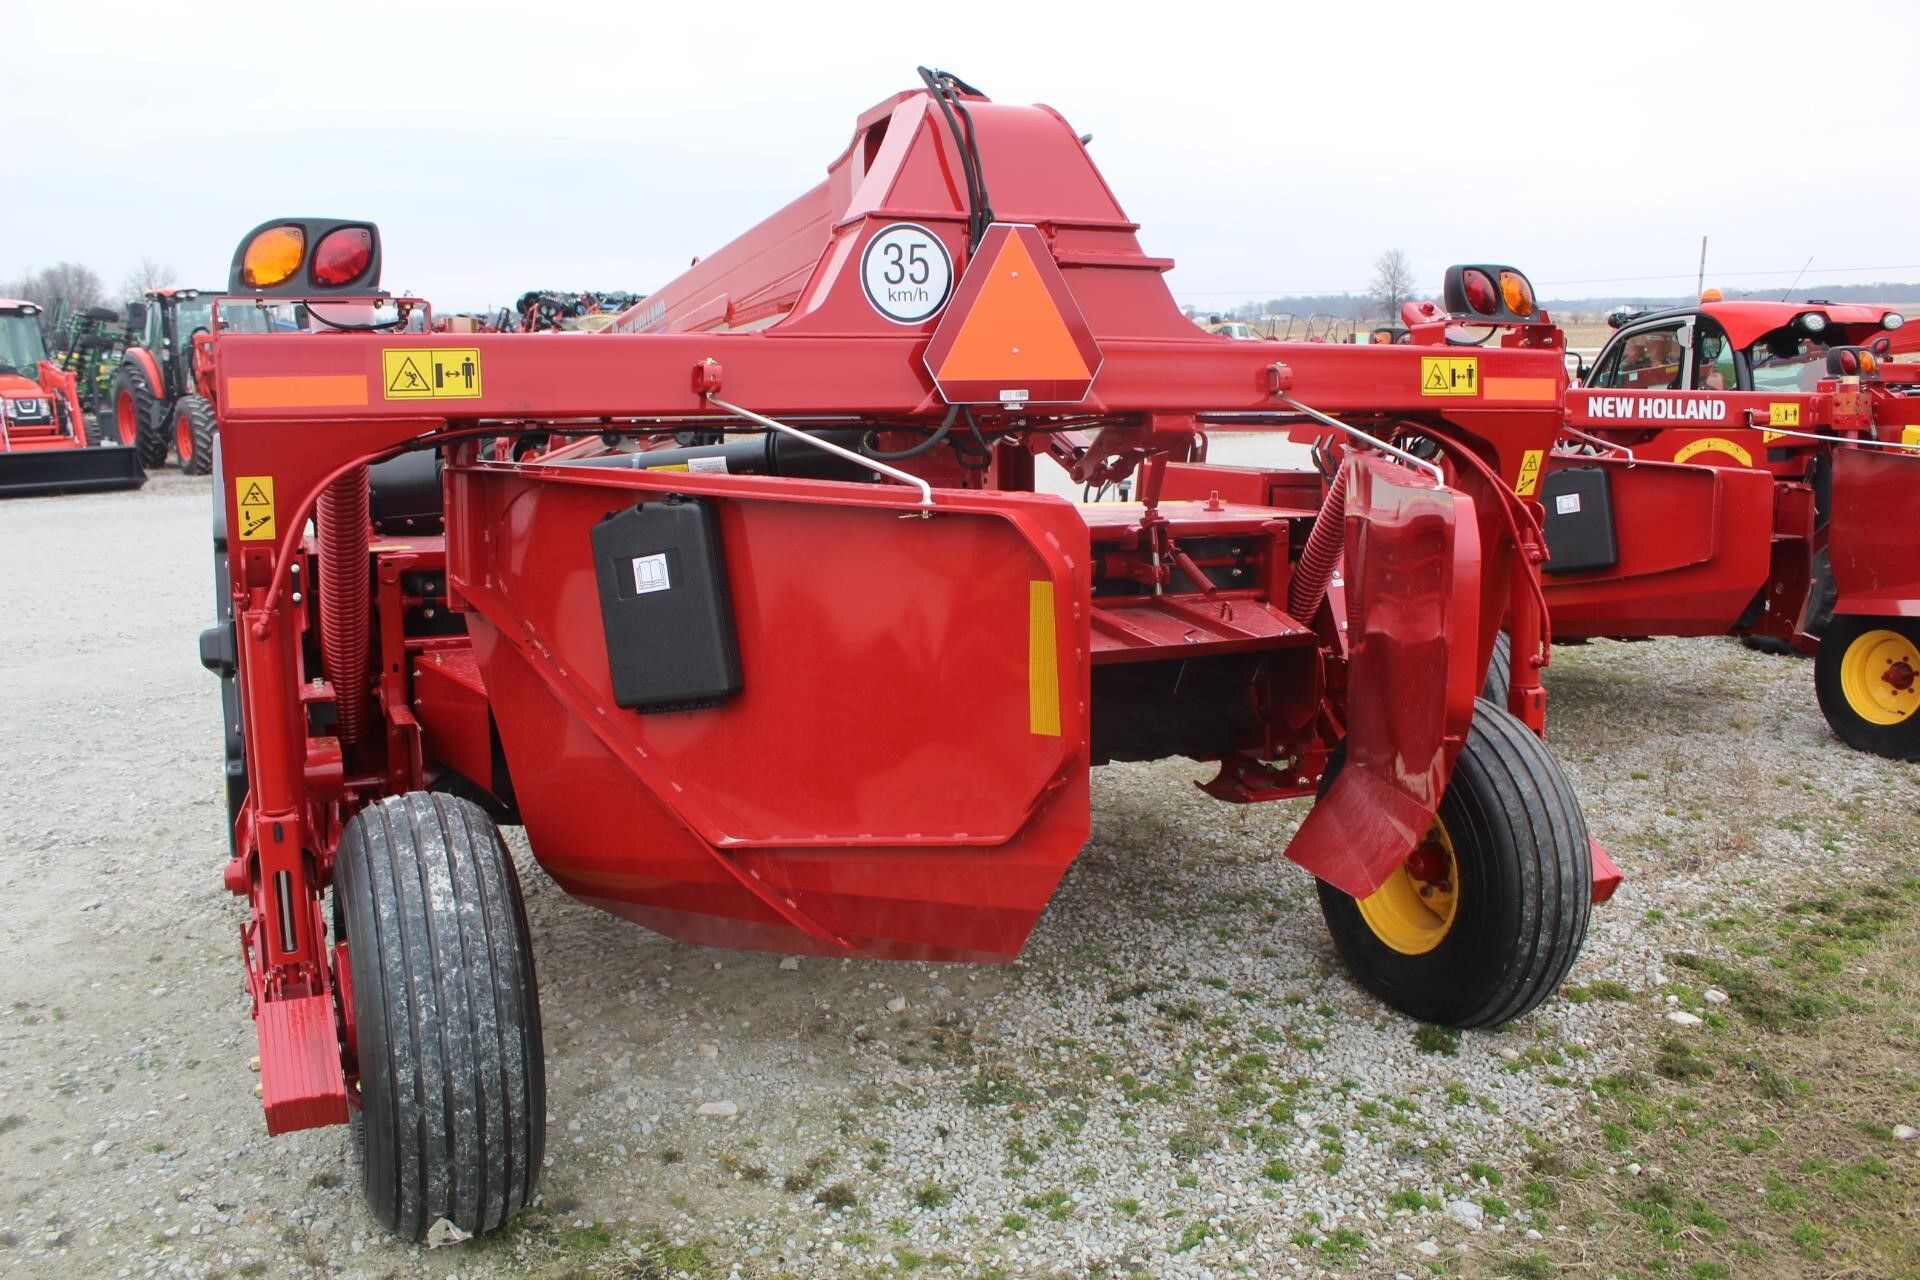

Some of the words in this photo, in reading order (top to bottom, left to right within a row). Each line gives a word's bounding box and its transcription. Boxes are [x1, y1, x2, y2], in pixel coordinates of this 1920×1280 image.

[884, 243, 929, 284] 35
[888, 287, 928, 302] km/h
[1588, 396, 1634, 418] NEW
[1638, 398, 1726, 420] HOLLAND
